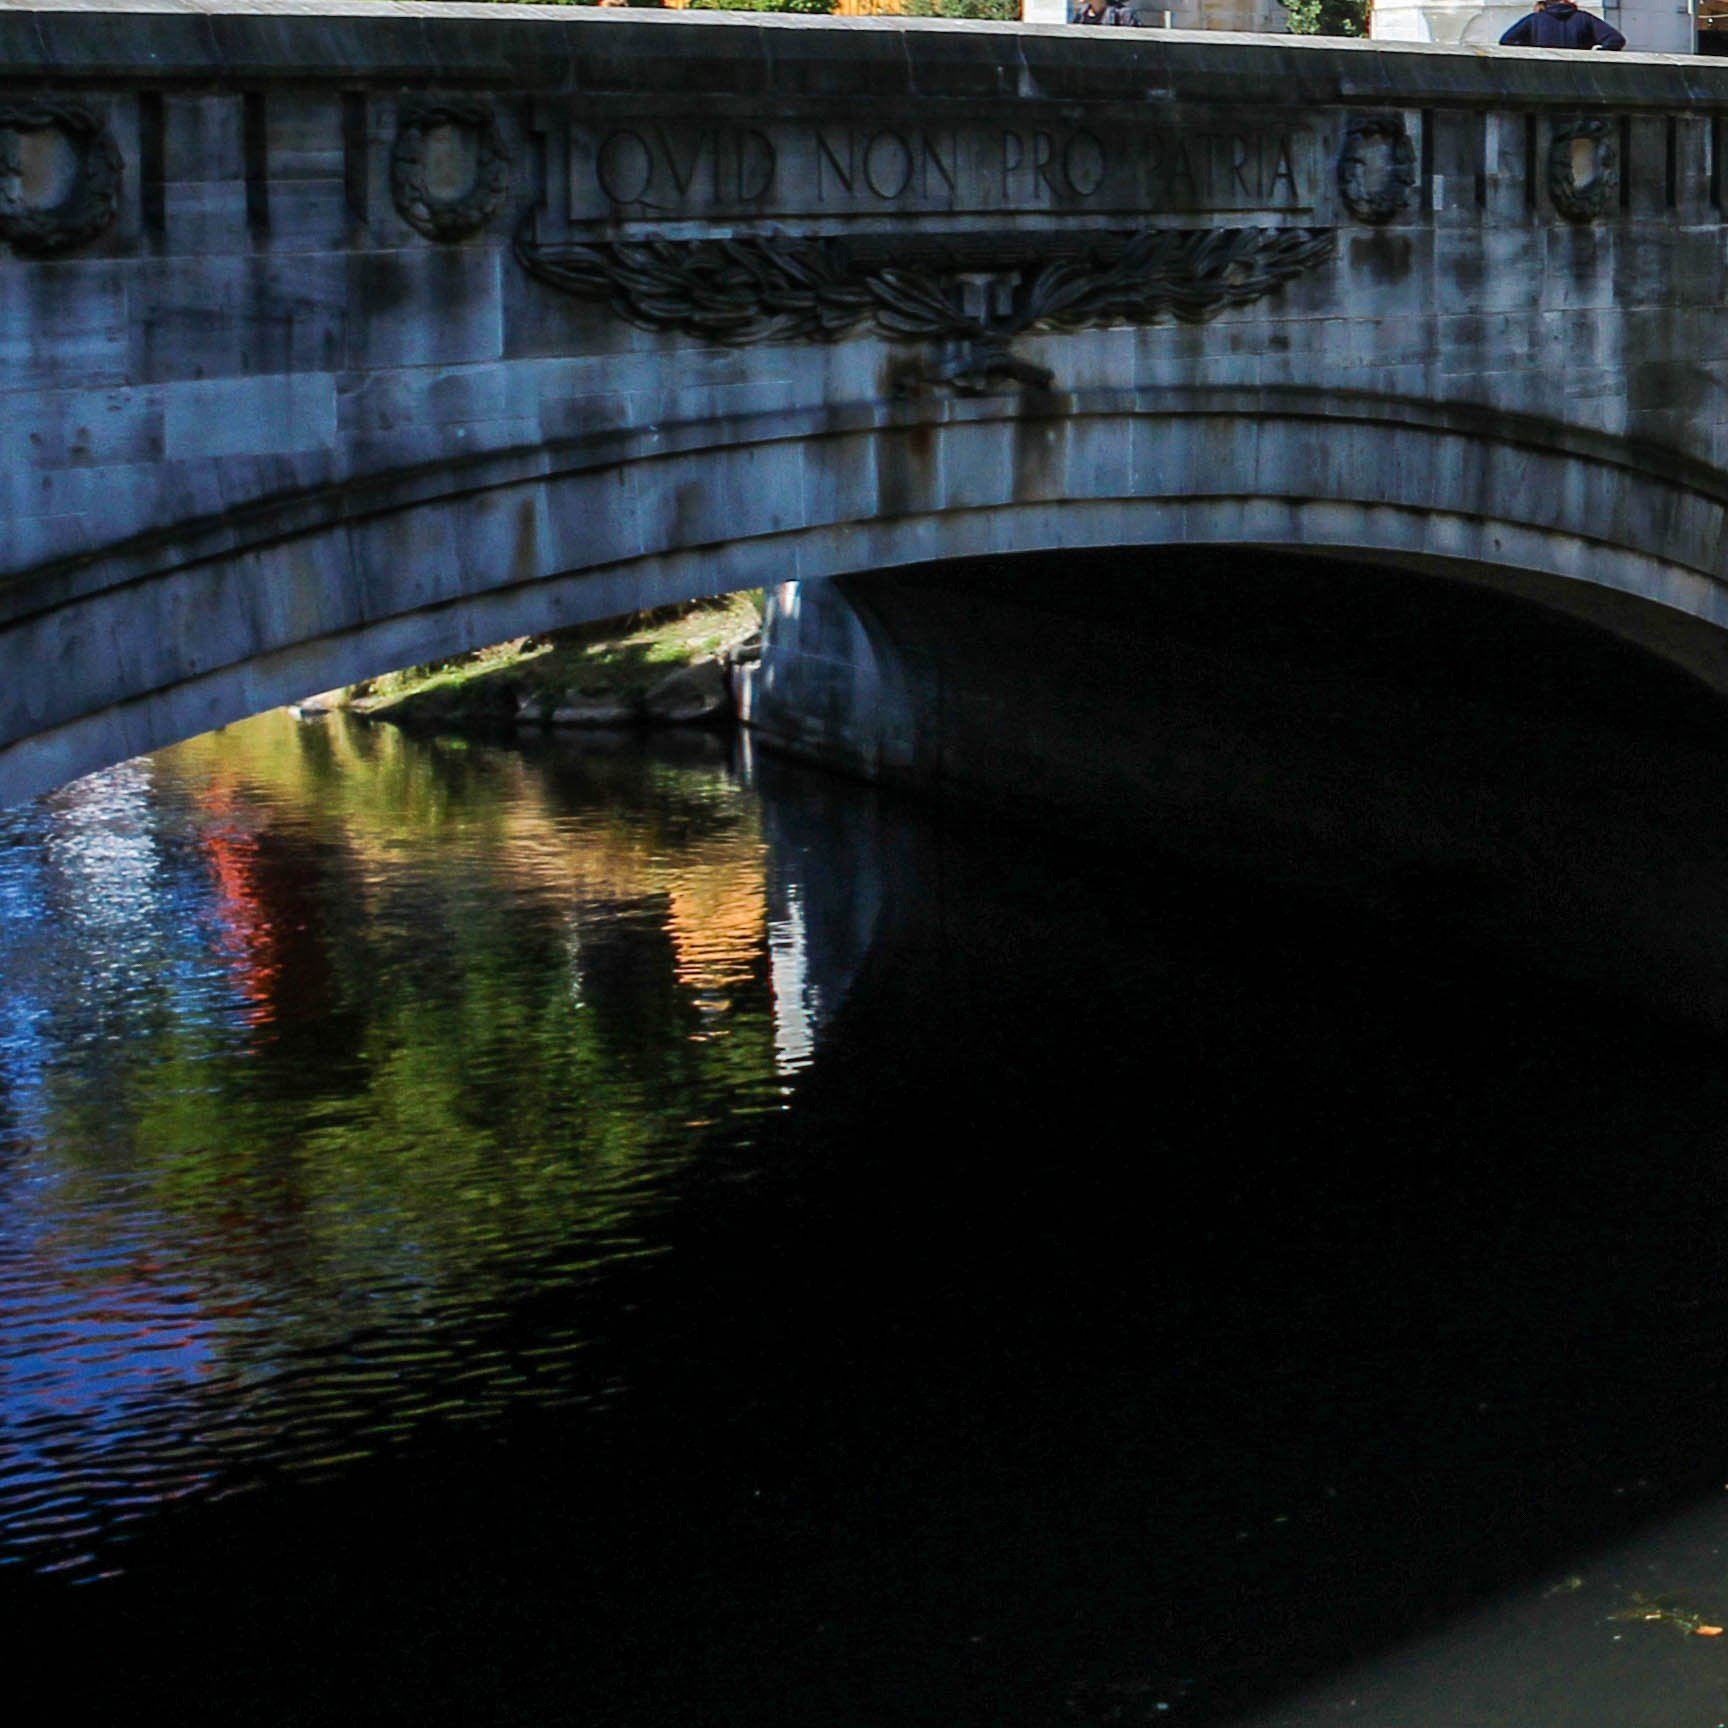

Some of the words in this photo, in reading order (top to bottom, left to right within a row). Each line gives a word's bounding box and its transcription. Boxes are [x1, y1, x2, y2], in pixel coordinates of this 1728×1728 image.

[596, 127, 776, 210] QVID
[815, 126, 957, 203] NON
[1002, 126, 1107, 204] PRO
[1147, 131, 1299, 202] PATRIA
